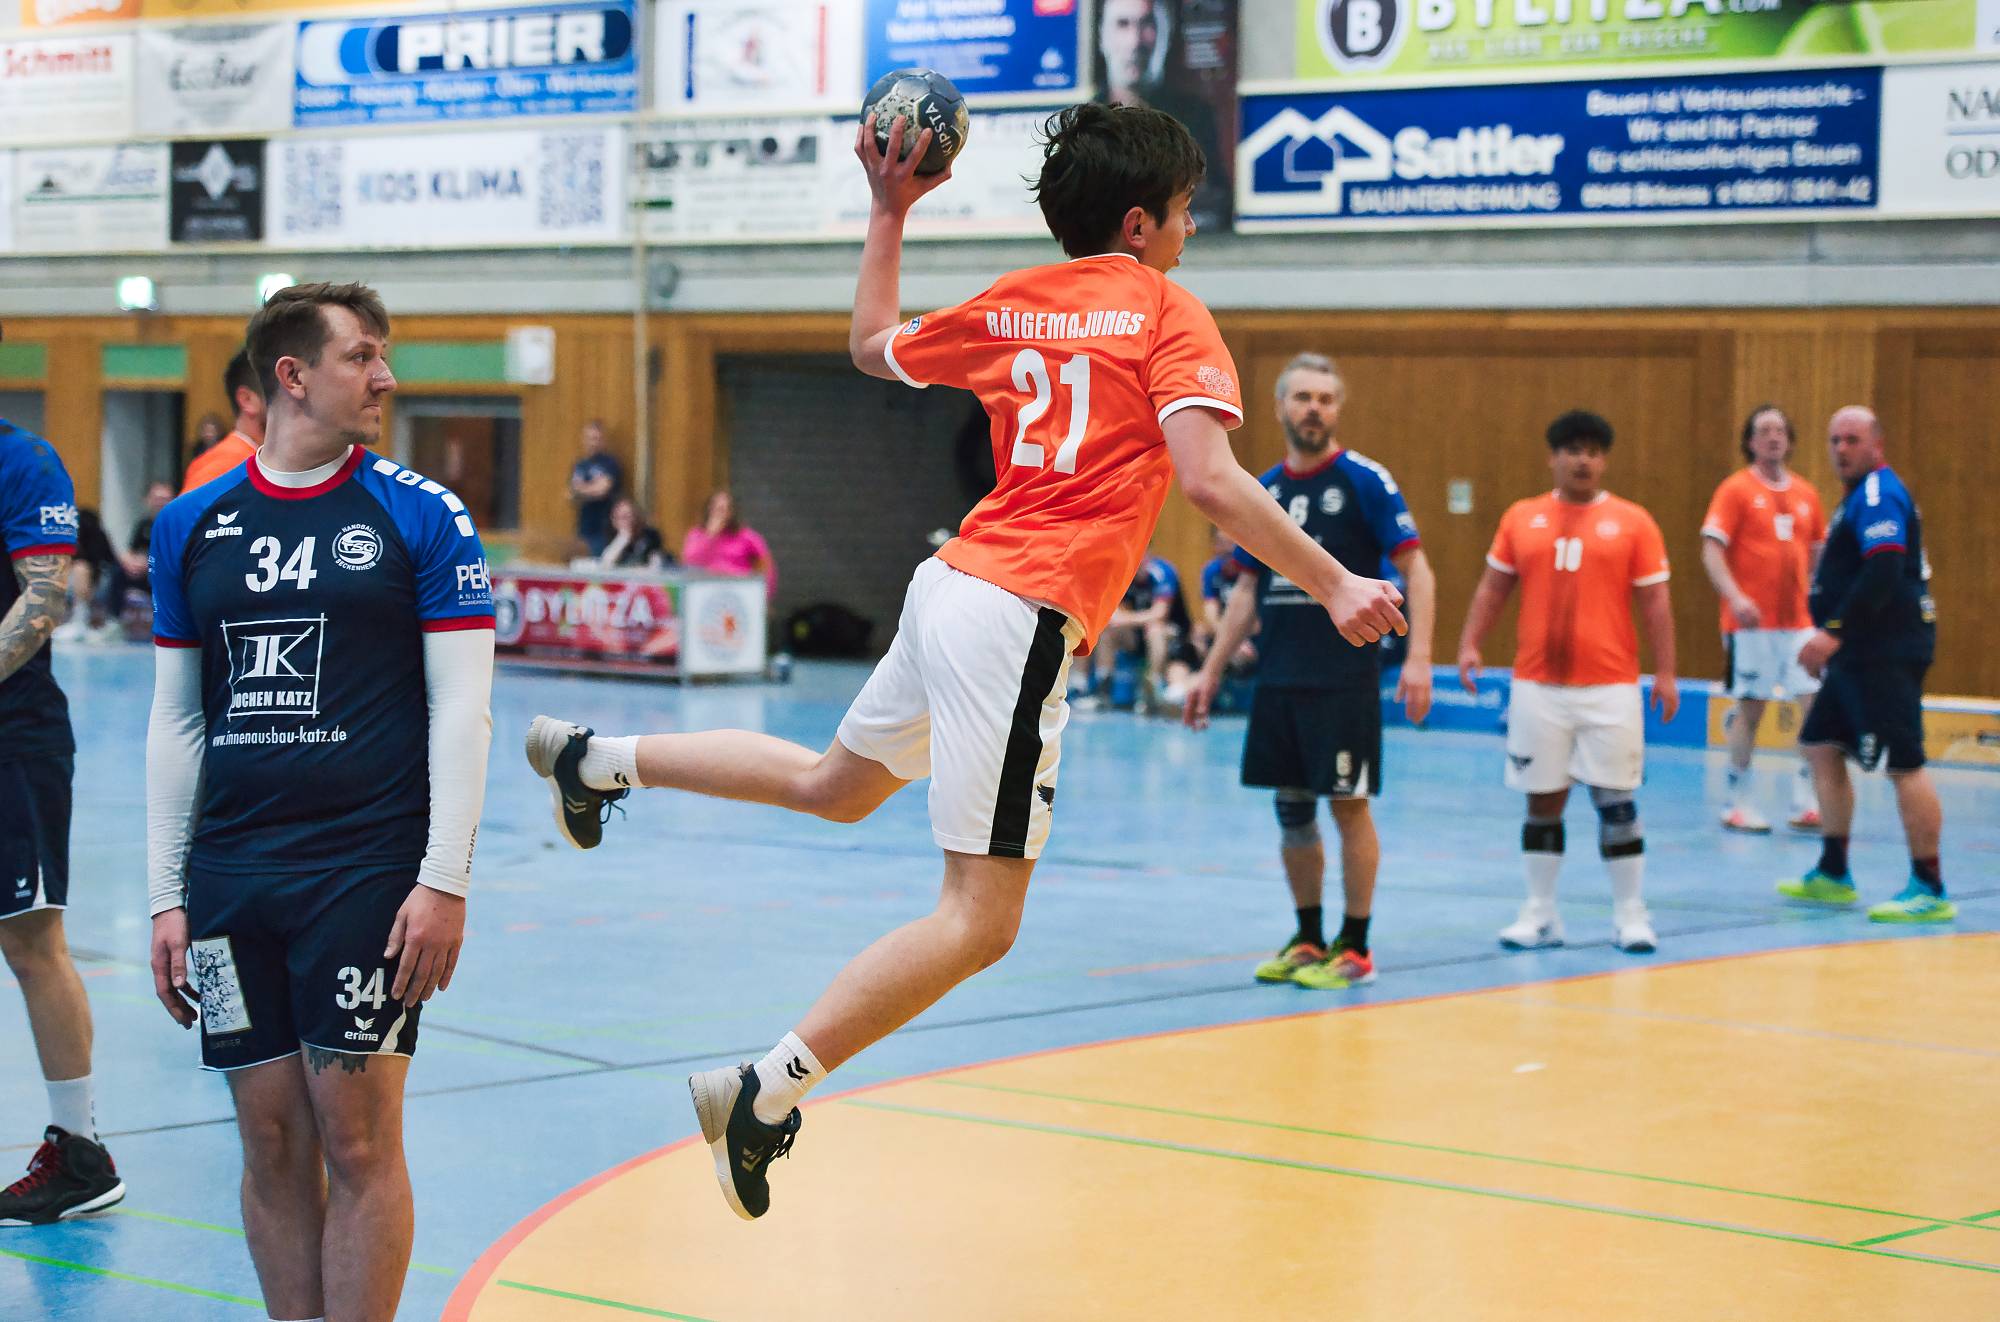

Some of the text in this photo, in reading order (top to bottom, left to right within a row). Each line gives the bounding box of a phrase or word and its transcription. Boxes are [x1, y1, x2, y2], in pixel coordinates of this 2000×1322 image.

[399, 11, 604, 73] PRIER
[925, 102, 953, 157] KIPSTA
[1627, 116, 1662, 143] Wir
[1664, 117, 1708, 141] sind
[1741, 112, 1819, 139] Partner
[1393, 124, 1564, 180] Sattler
[429, 166, 523, 200] KLIMA
[986, 307, 1146, 339] BÄIGEMAJUNGS
[1011, 348, 1090, 475] 21
[205, 526, 243, 539] erima
[342, 523, 377, 535] HANDBALL
[341, 541, 375, 553] TSG
[1554, 537, 1583, 572] 10
[245, 536, 317, 593] 34
[525, 585, 655, 628] BYLITZA
[231, 691, 313, 709] JOCHEN KATZ
[212, 725, 348, 748] www.innenausbau-katz.de
[336, 967, 387, 1010] 34
[344, 1031, 379, 1042] erima
